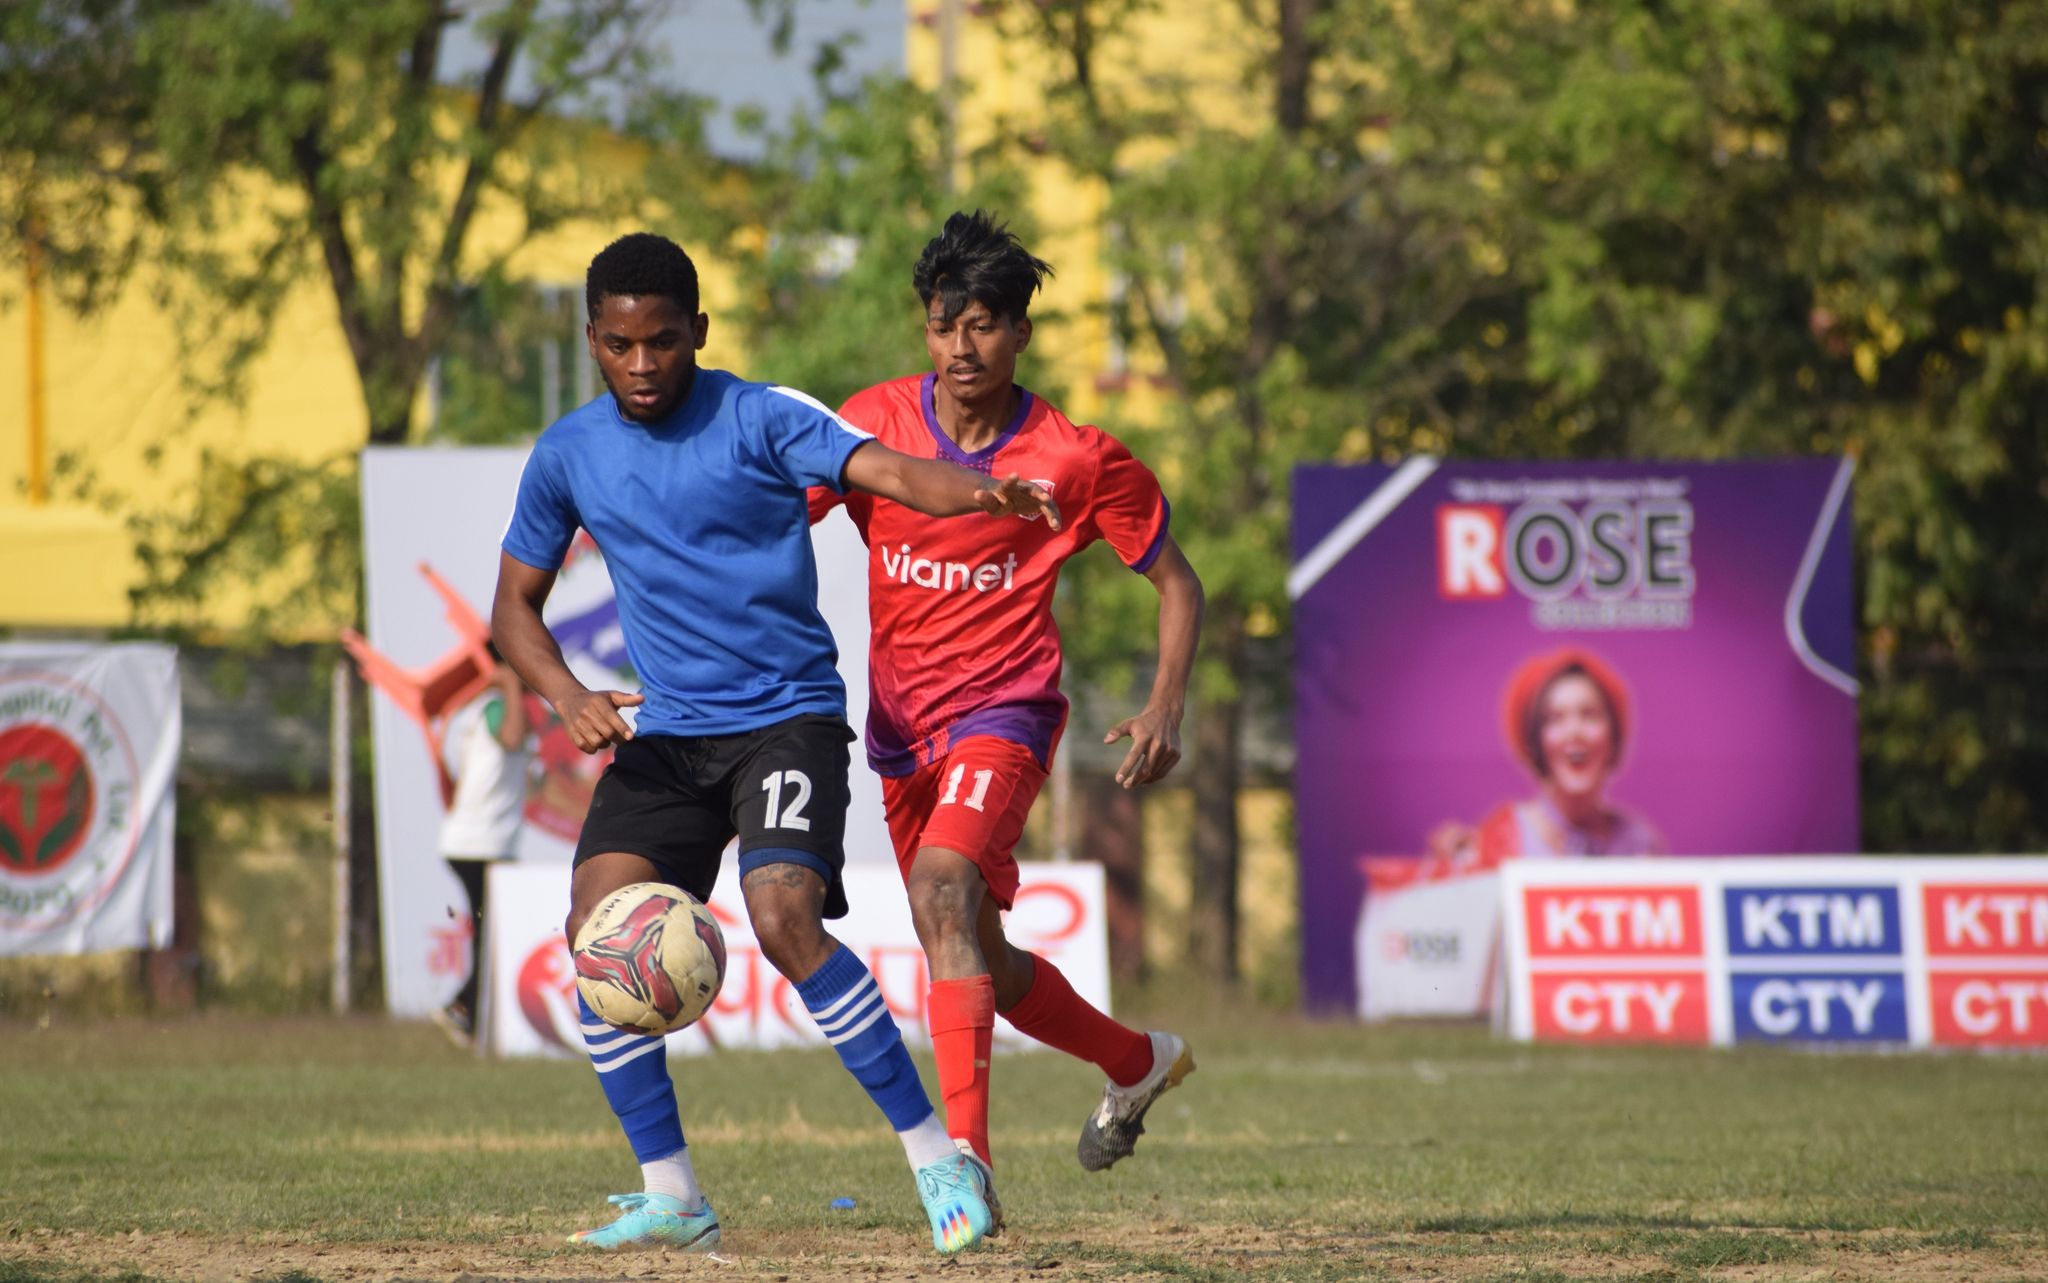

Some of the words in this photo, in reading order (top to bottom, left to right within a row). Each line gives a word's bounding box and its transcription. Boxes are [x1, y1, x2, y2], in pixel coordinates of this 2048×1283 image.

[882, 544, 1017, 592] vianet
[1440, 502, 1692, 599] ROSE
[762, 770, 812, 832] 12
[940, 763, 993, 812] 11
[1544, 896, 1683, 948] KTM
[1742, 895, 1884, 948] KTM
[1553, 980, 1683, 1034] CTY
[1751, 980, 1884, 1035] CTY
[1953, 980, 2048, 1035] CT
